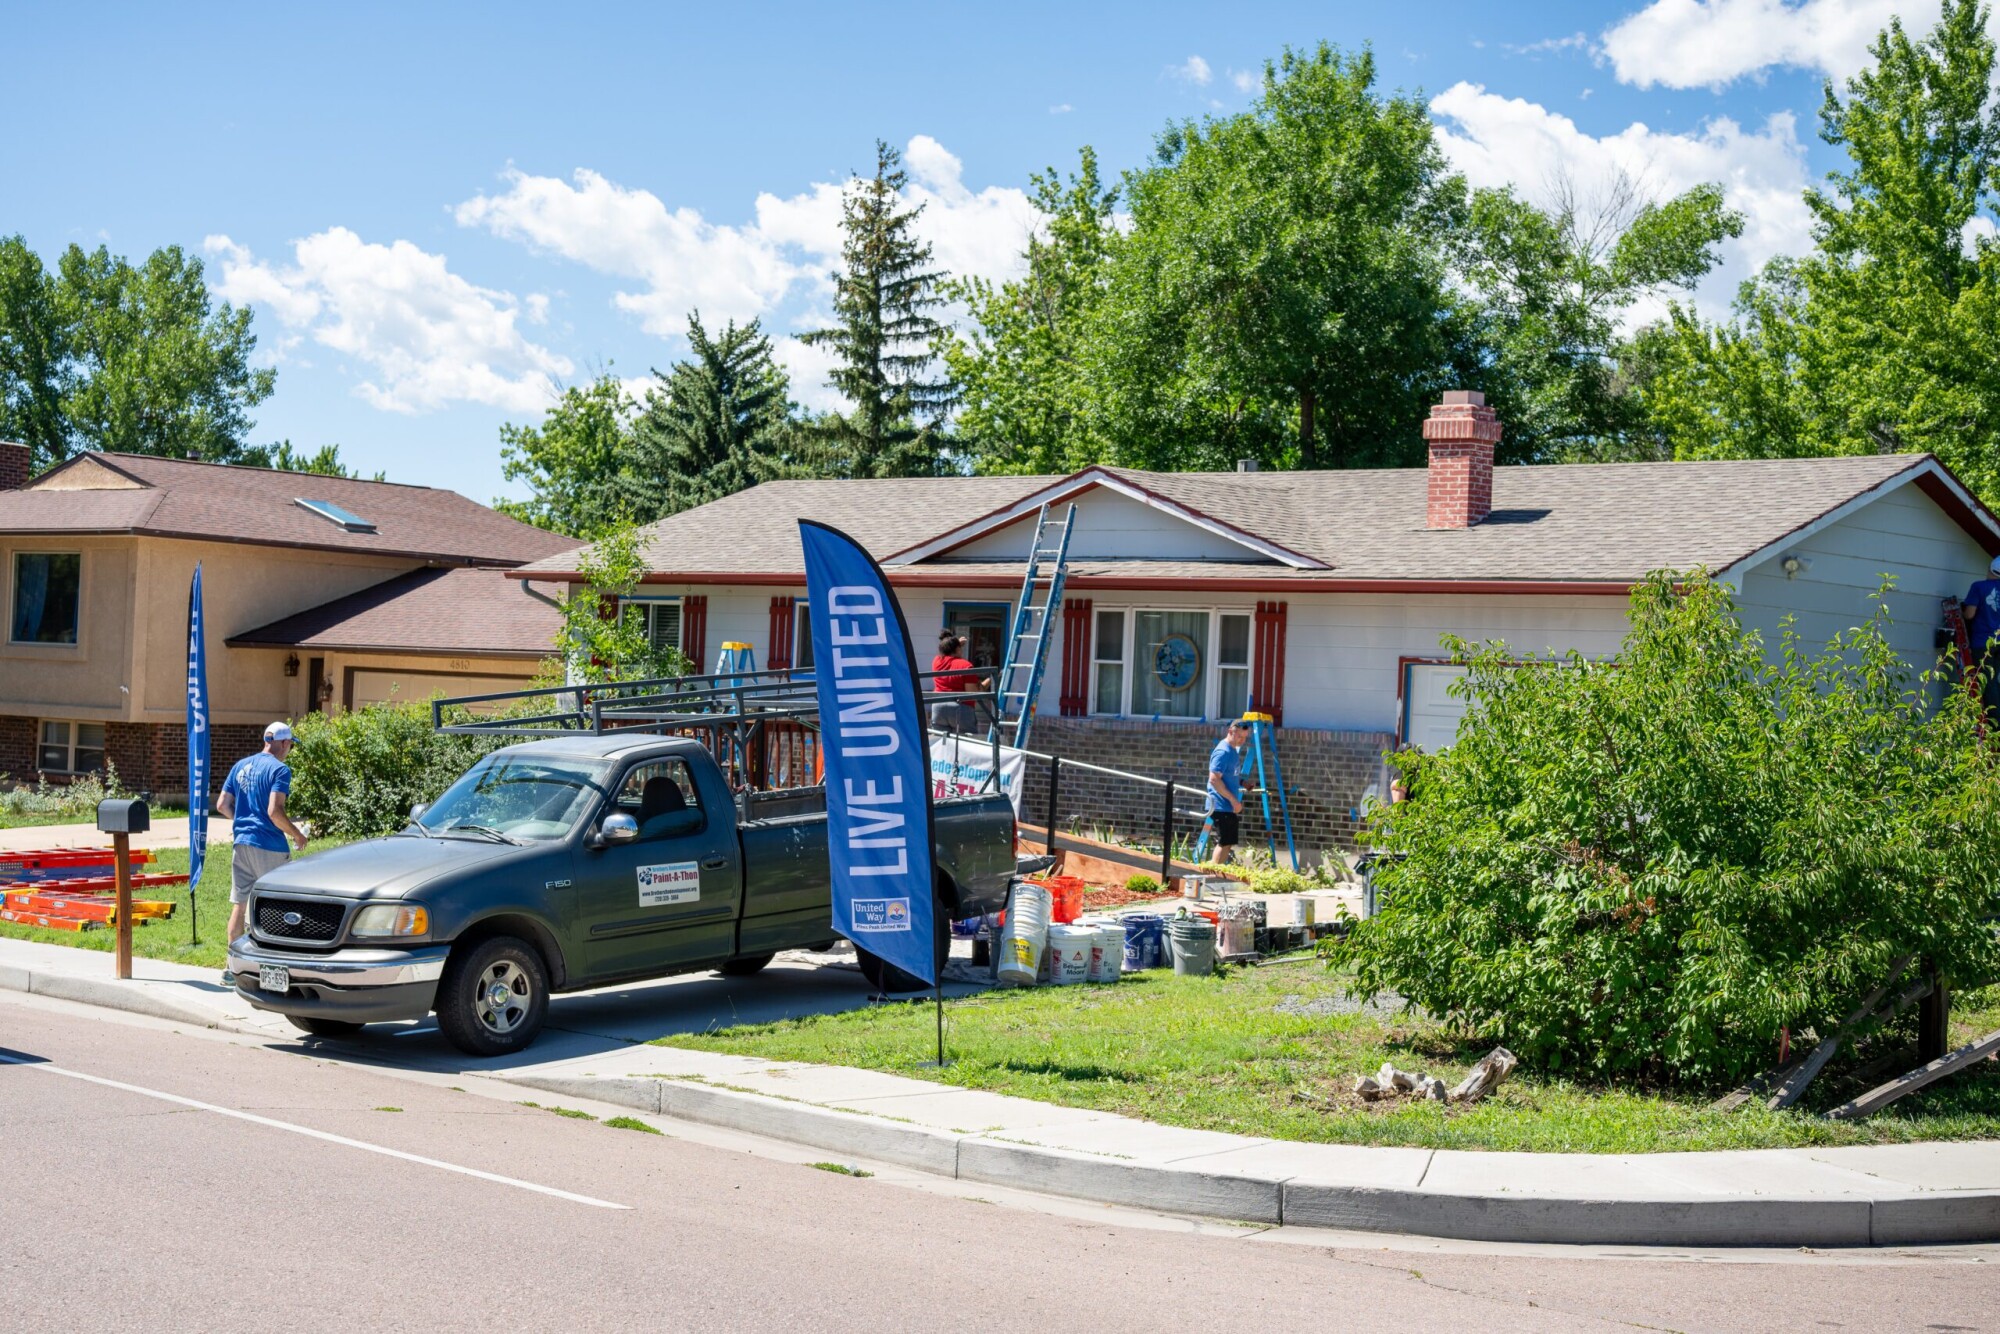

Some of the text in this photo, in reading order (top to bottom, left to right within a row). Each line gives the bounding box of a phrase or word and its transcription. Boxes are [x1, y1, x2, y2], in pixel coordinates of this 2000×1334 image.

[828, 585, 908, 877] LIVE UNITED
[653, 870, 698, 883] Paint-A-Thon
[855, 903, 884, 912] United
[866, 912, 884, 924] Way
